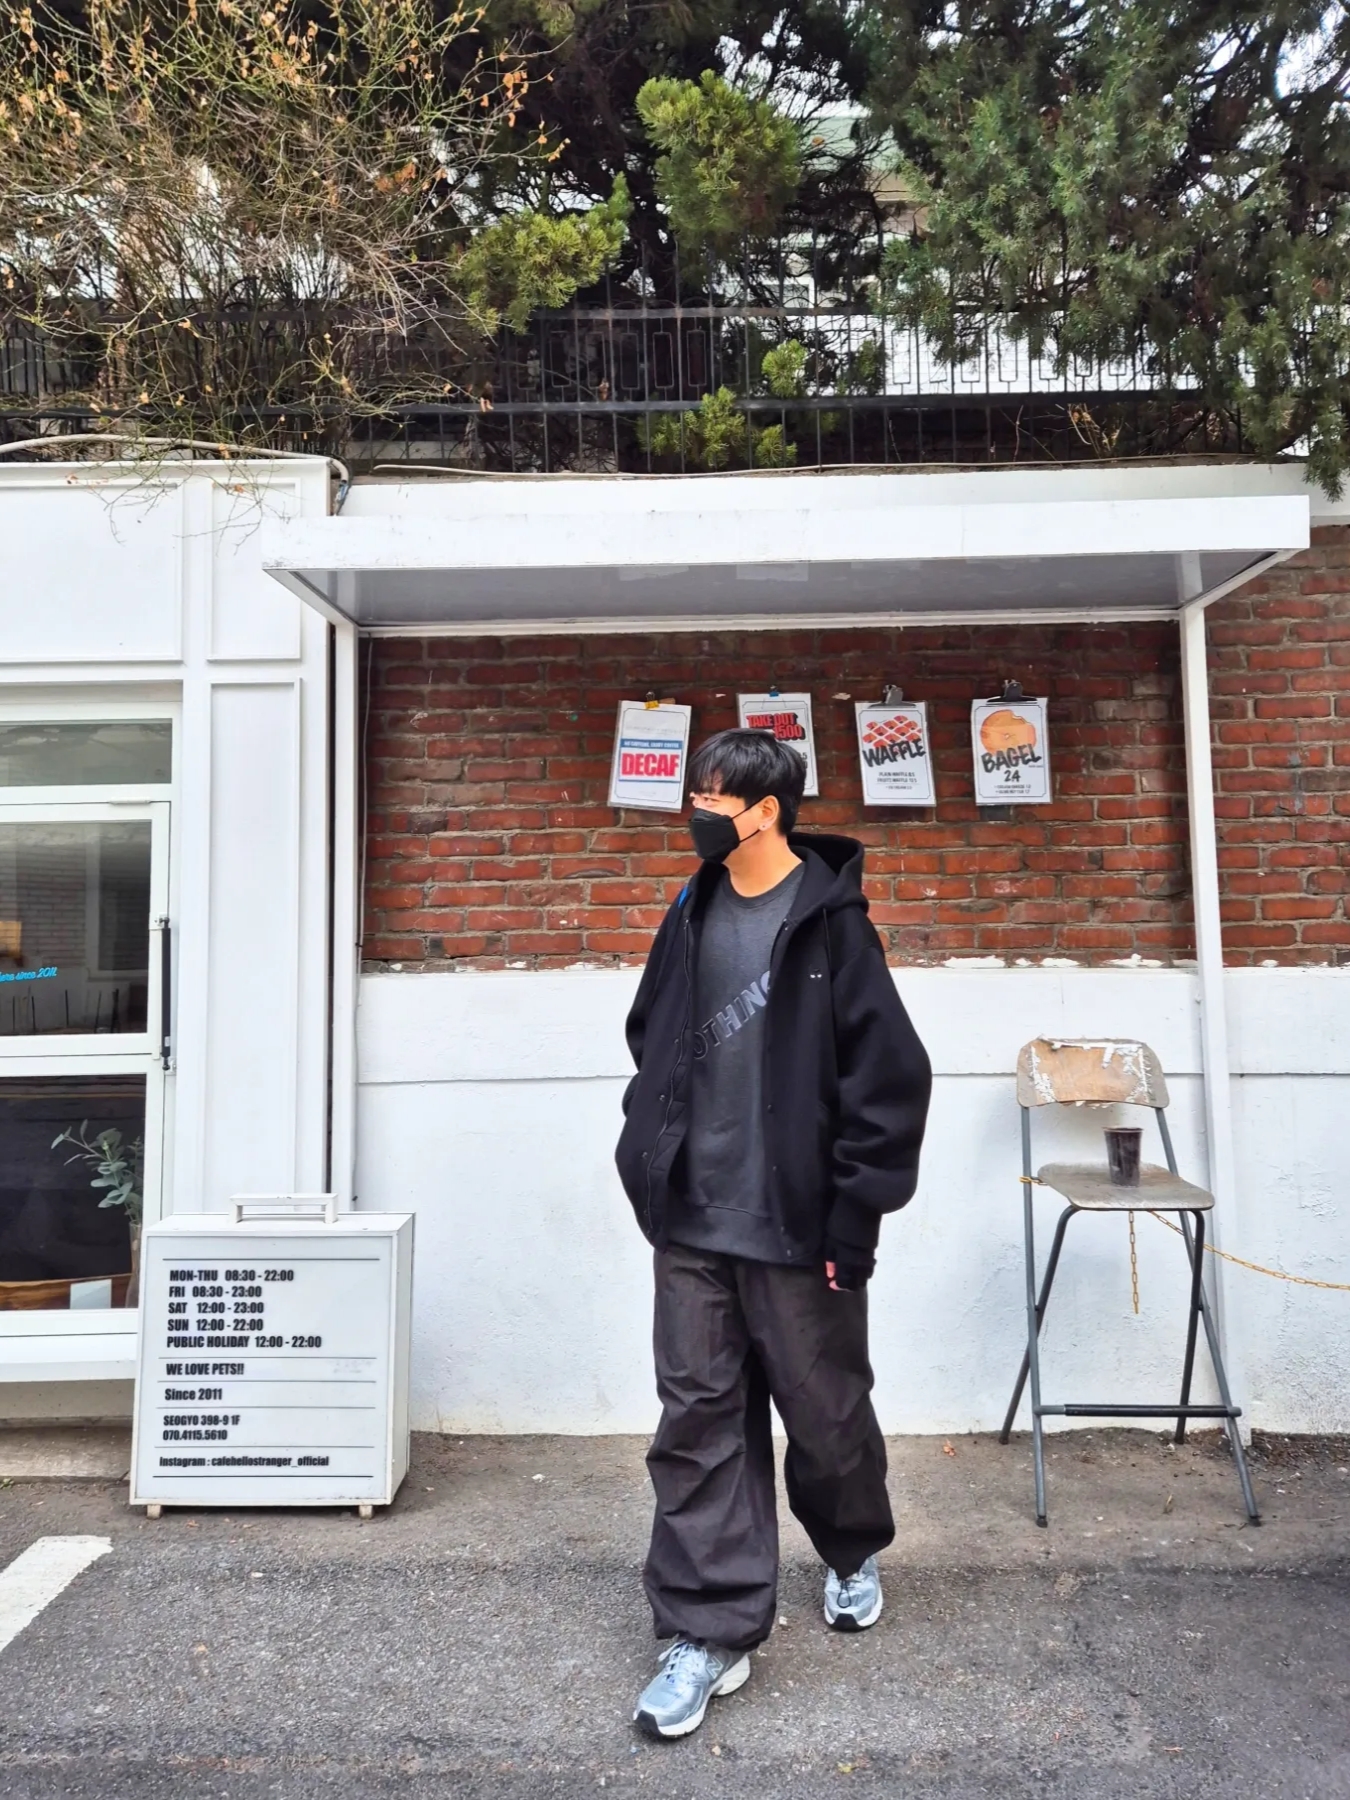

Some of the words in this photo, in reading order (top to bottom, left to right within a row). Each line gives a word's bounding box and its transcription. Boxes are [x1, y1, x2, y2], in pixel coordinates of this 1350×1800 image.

[746, 714, 774, 729] TAKE
[773, 712, 798, 726] OUT
[774, 723, 806, 741] 1500
[861, 737, 927, 768] WAFFLE
[980, 743, 1042, 773] BAGEL
[620, 752, 680, 777] DECAF
[169, 1269, 218, 1281] MON-THU
[224, 1269, 256, 1281] 08:30
[263, 1269, 294, 1281] 22:00
[169, 1286, 185, 1297] FRI
[192, 1286, 223, 1297] 08:30
[231, 1286, 262, 1297] 23:00
[168, 1302, 187, 1313] SAT
[196, 1302, 225, 1313] 12:00
[233, 1302, 264, 1313] 23:00
[167, 1318, 189, 1331] SUN
[196, 1318, 224, 1331] 12:00
[233, 1318, 264, 1331] 22:00
[167, 1336, 205, 1348] PUBLIC
[206, 1336, 250, 1348] HOLIDAY
[255, 1336, 283, 1348] 12:00
[291, 1336, 322, 1348] 22:00
[166, 1363, 183, 1375] WE
[184, 1363, 210, 1375] LOVE
[211, 1363, 244, 1375] PETS!!
[164, 1388, 196, 1400] Since
[197, 1388, 222, 1400] 2011
[163, 1414, 199, 1426] SEOGYO
[200, 1414, 229, 1426] 398-9
[231, 1414, 241, 1425] 1F
[162, 1429, 228, 1441] 070.4115.5610
[159, 1456, 206, 1467] Instagram
[211, 1456, 330, 1468] cafehellostranger_official
